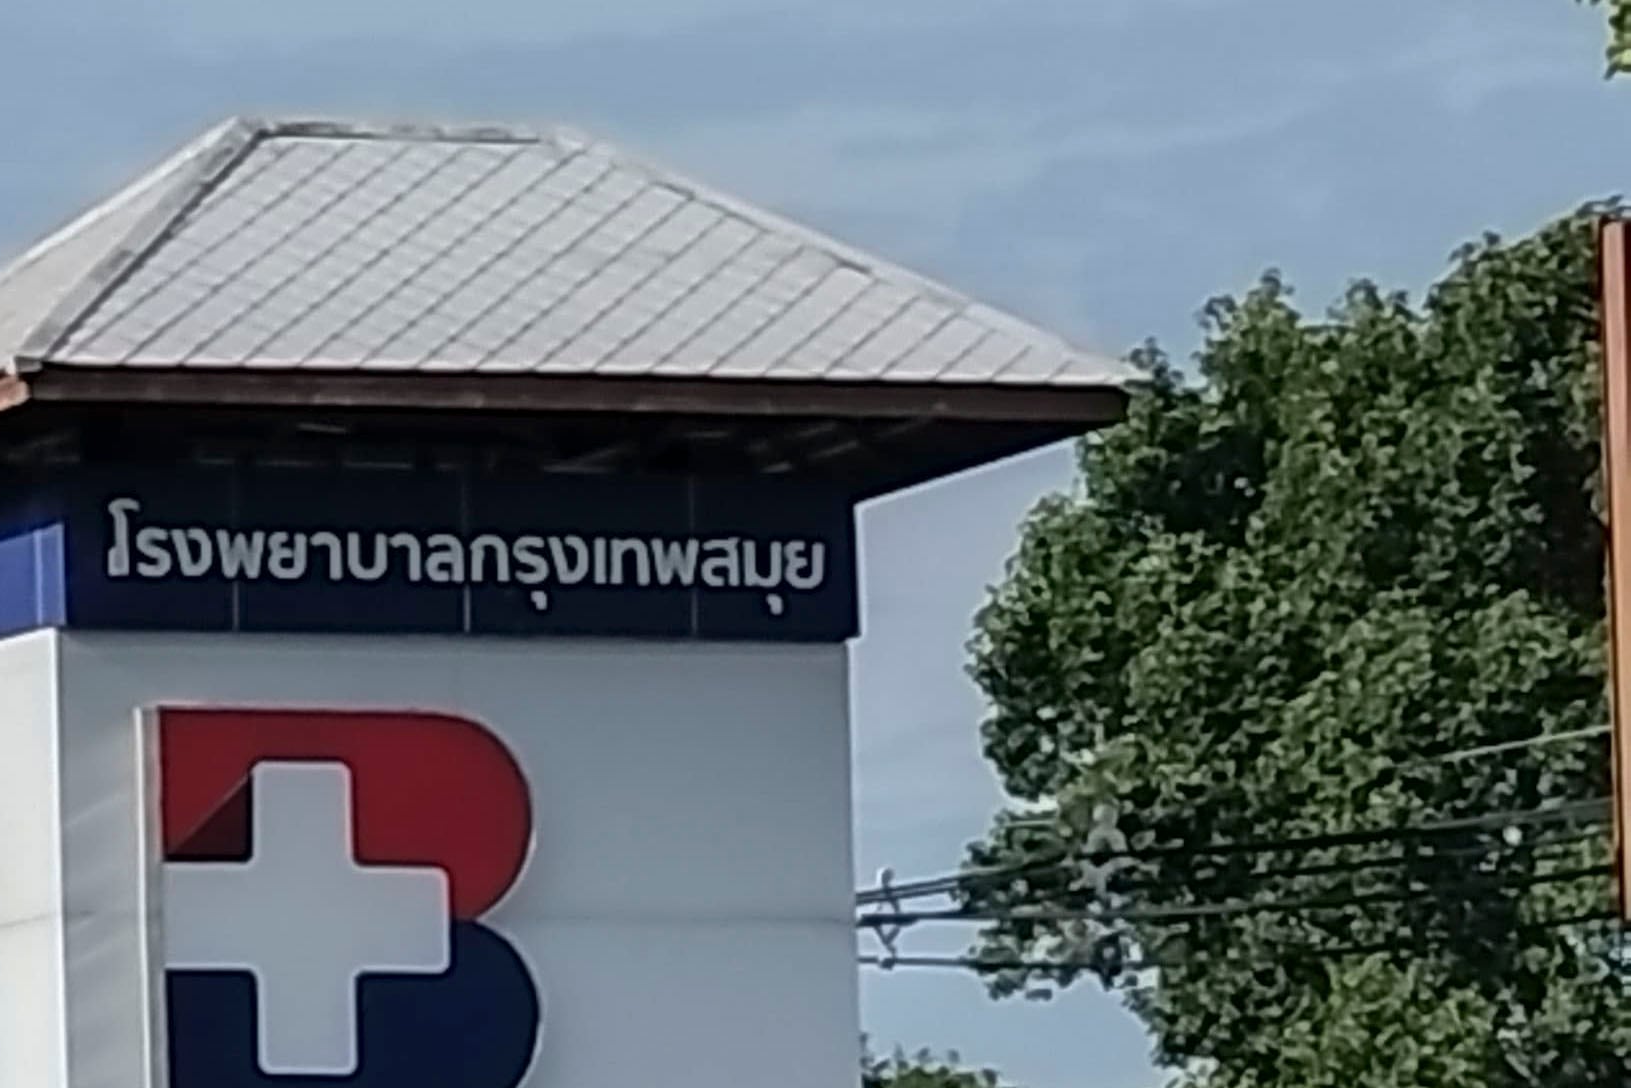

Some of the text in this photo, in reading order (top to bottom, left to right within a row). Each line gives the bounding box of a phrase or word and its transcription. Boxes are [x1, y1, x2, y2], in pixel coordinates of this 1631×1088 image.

[106, 498, 826, 615] โรงพยาบาลกรุงเทพสมุย
